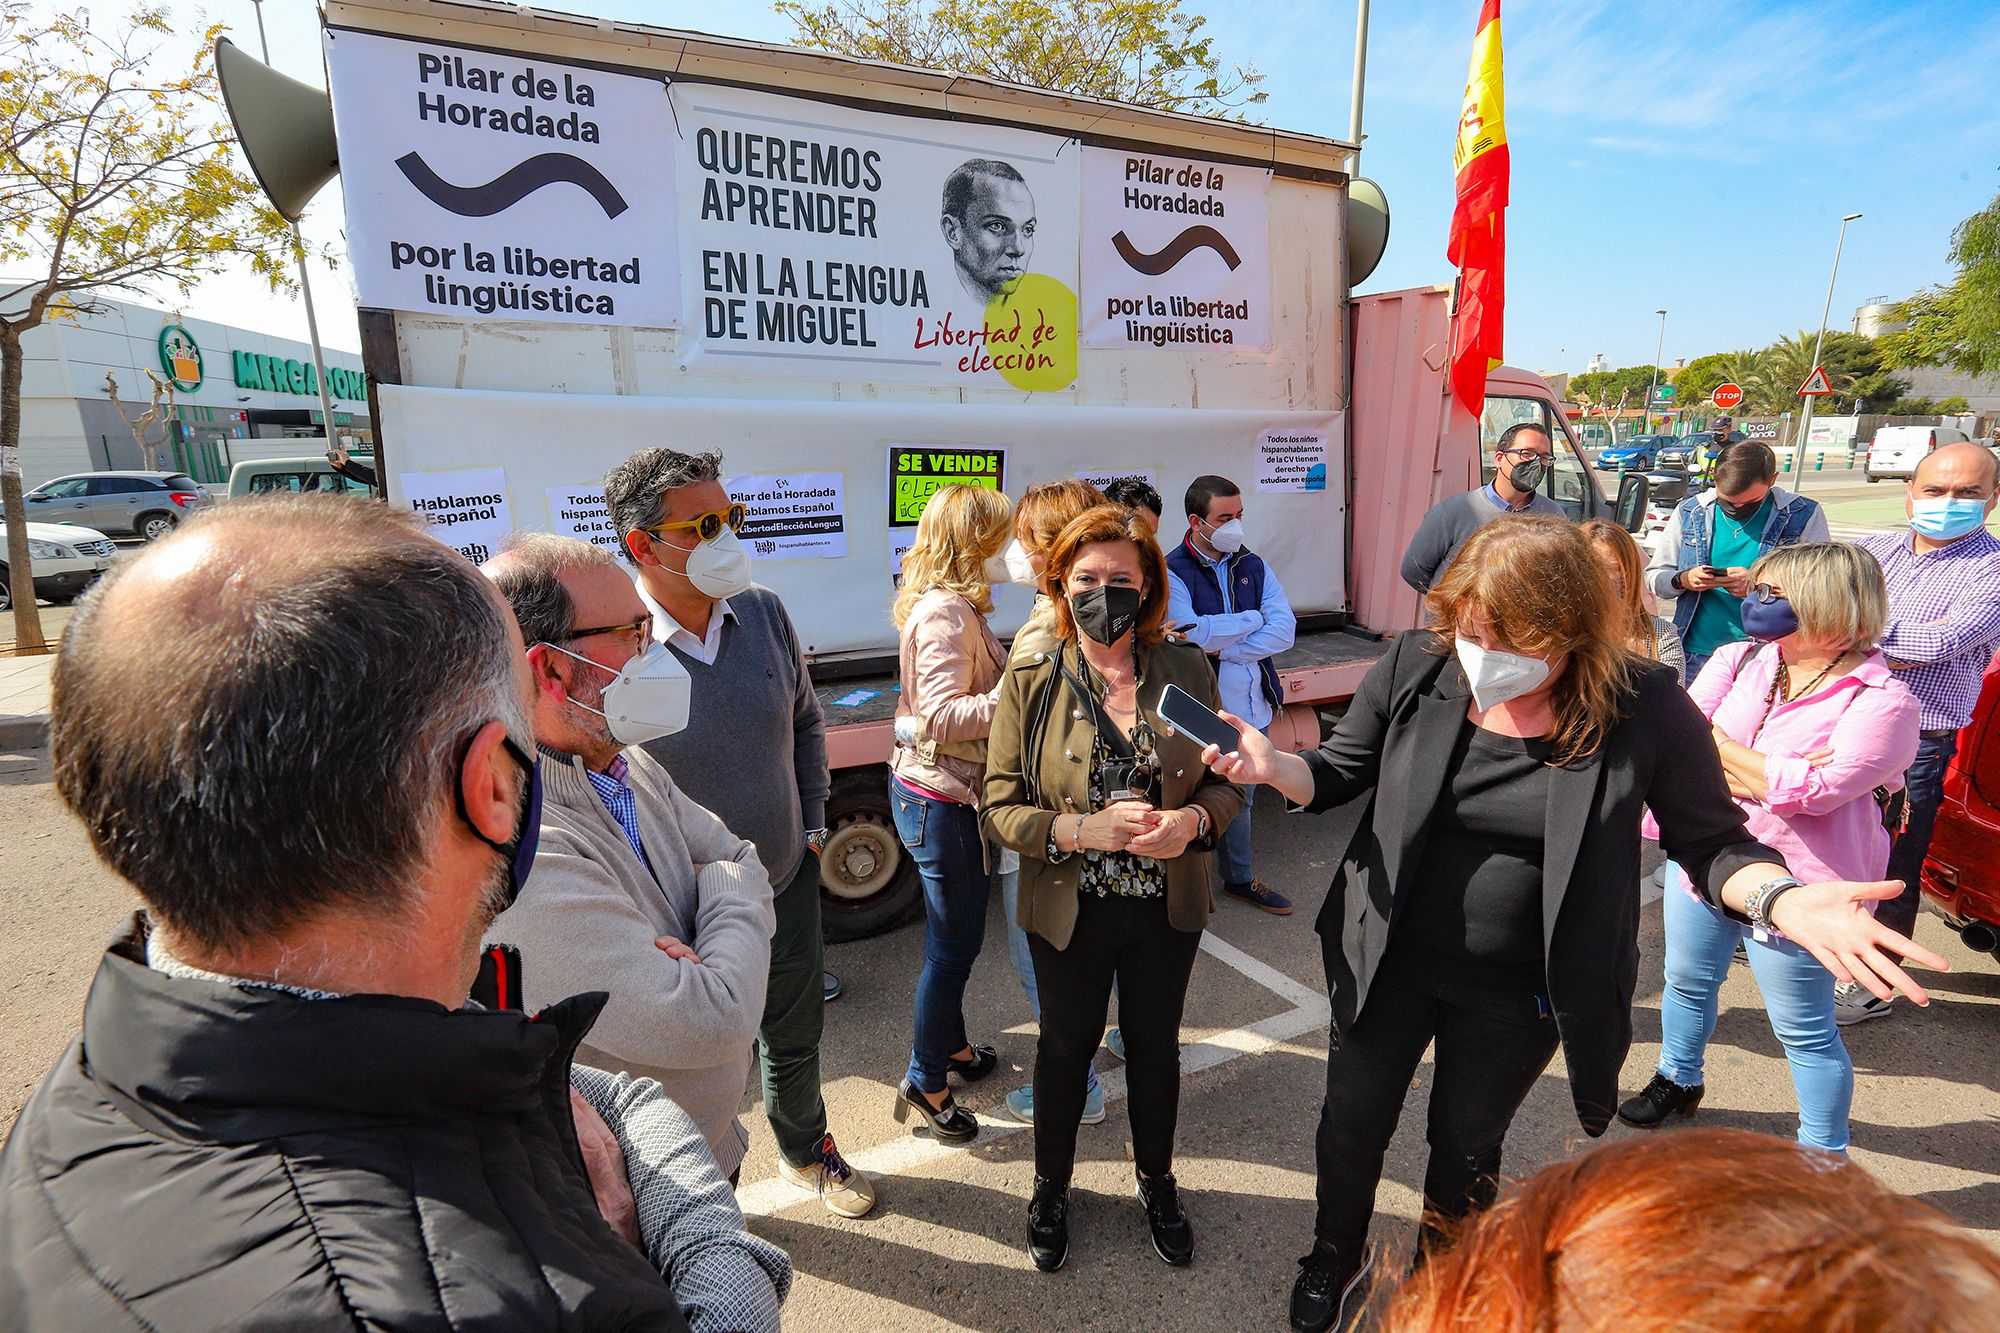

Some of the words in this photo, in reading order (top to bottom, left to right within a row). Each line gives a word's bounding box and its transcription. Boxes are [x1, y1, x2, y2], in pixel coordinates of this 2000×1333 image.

[418, 53, 504, 93] Pilar
[511, 68, 557, 100] de
[564, 74, 595, 107] la
[418, 92, 600, 144] Horadada
[696, 127, 882, 192] QUEREMOS
[1125, 158, 1174, 185] Pilar
[1176, 165, 1203, 188] de
[1206, 167, 1224, 191] la
[701, 177, 878, 239] APRENDER
[1124, 187, 1224, 217] Horadada
[390, 241, 456, 270] por
[463, 243, 495, 273] la
[503, 246, 641, 284] libertad
[702, 250, 748, 294] EN
[756, 254, 798, 298] LA
[806, 260, 930, 308] LENGUA
[425, 274, 614, 315] lingüística
[1107, 297, 1144, 319] por
[1147, 295, 1167, 316] la
[1169, 296, 1248, 320] libertad
[705, 297, 748, 339] DE
[756, 301, 877, 347] MIGUEL
[914, 309, 1021, 349] Libertad
[1032, 308, 1057, 341] de
[1126, 320, 1233, 347] lingüística
[958, 341, 1056, 373] elección
[1715, 392, 1740, 400] STOP
[1267, 435, 1288, 443] Todos
[1300, 435, 1318, 443] niños
[1261, 445, 1324, 454] hispanohablantes
[897, 453, 923, 472] SE
[929, 454, 997, 472] VENDE
[1275, 465, 1306, 473] derecho
[775, 478, 789, 489] En
[1084, 477, 1111, 486] Todos
[1260, 476, 1290, 484] estudiar
[412, 493, 503, 511] Hablamos
[567, 494, 606, 505] Todos
[730, 492, 756, 502] Pilar
[757, 491, 771, 501] de
[772, 490, 782, 500] la
[784, 488, 836, 499] Horadada
[425, 506, 497, 527] Español
[560, 509, 610, 520] hispano
[744, 505, 791, 517] ablamos
[792, 502, 834, 514] Español
[573, 523, 589, 533] de
[591, 522, 603, 531] la
[604, 521, 614, 530] C
[590, 535, 619, 545] dere
